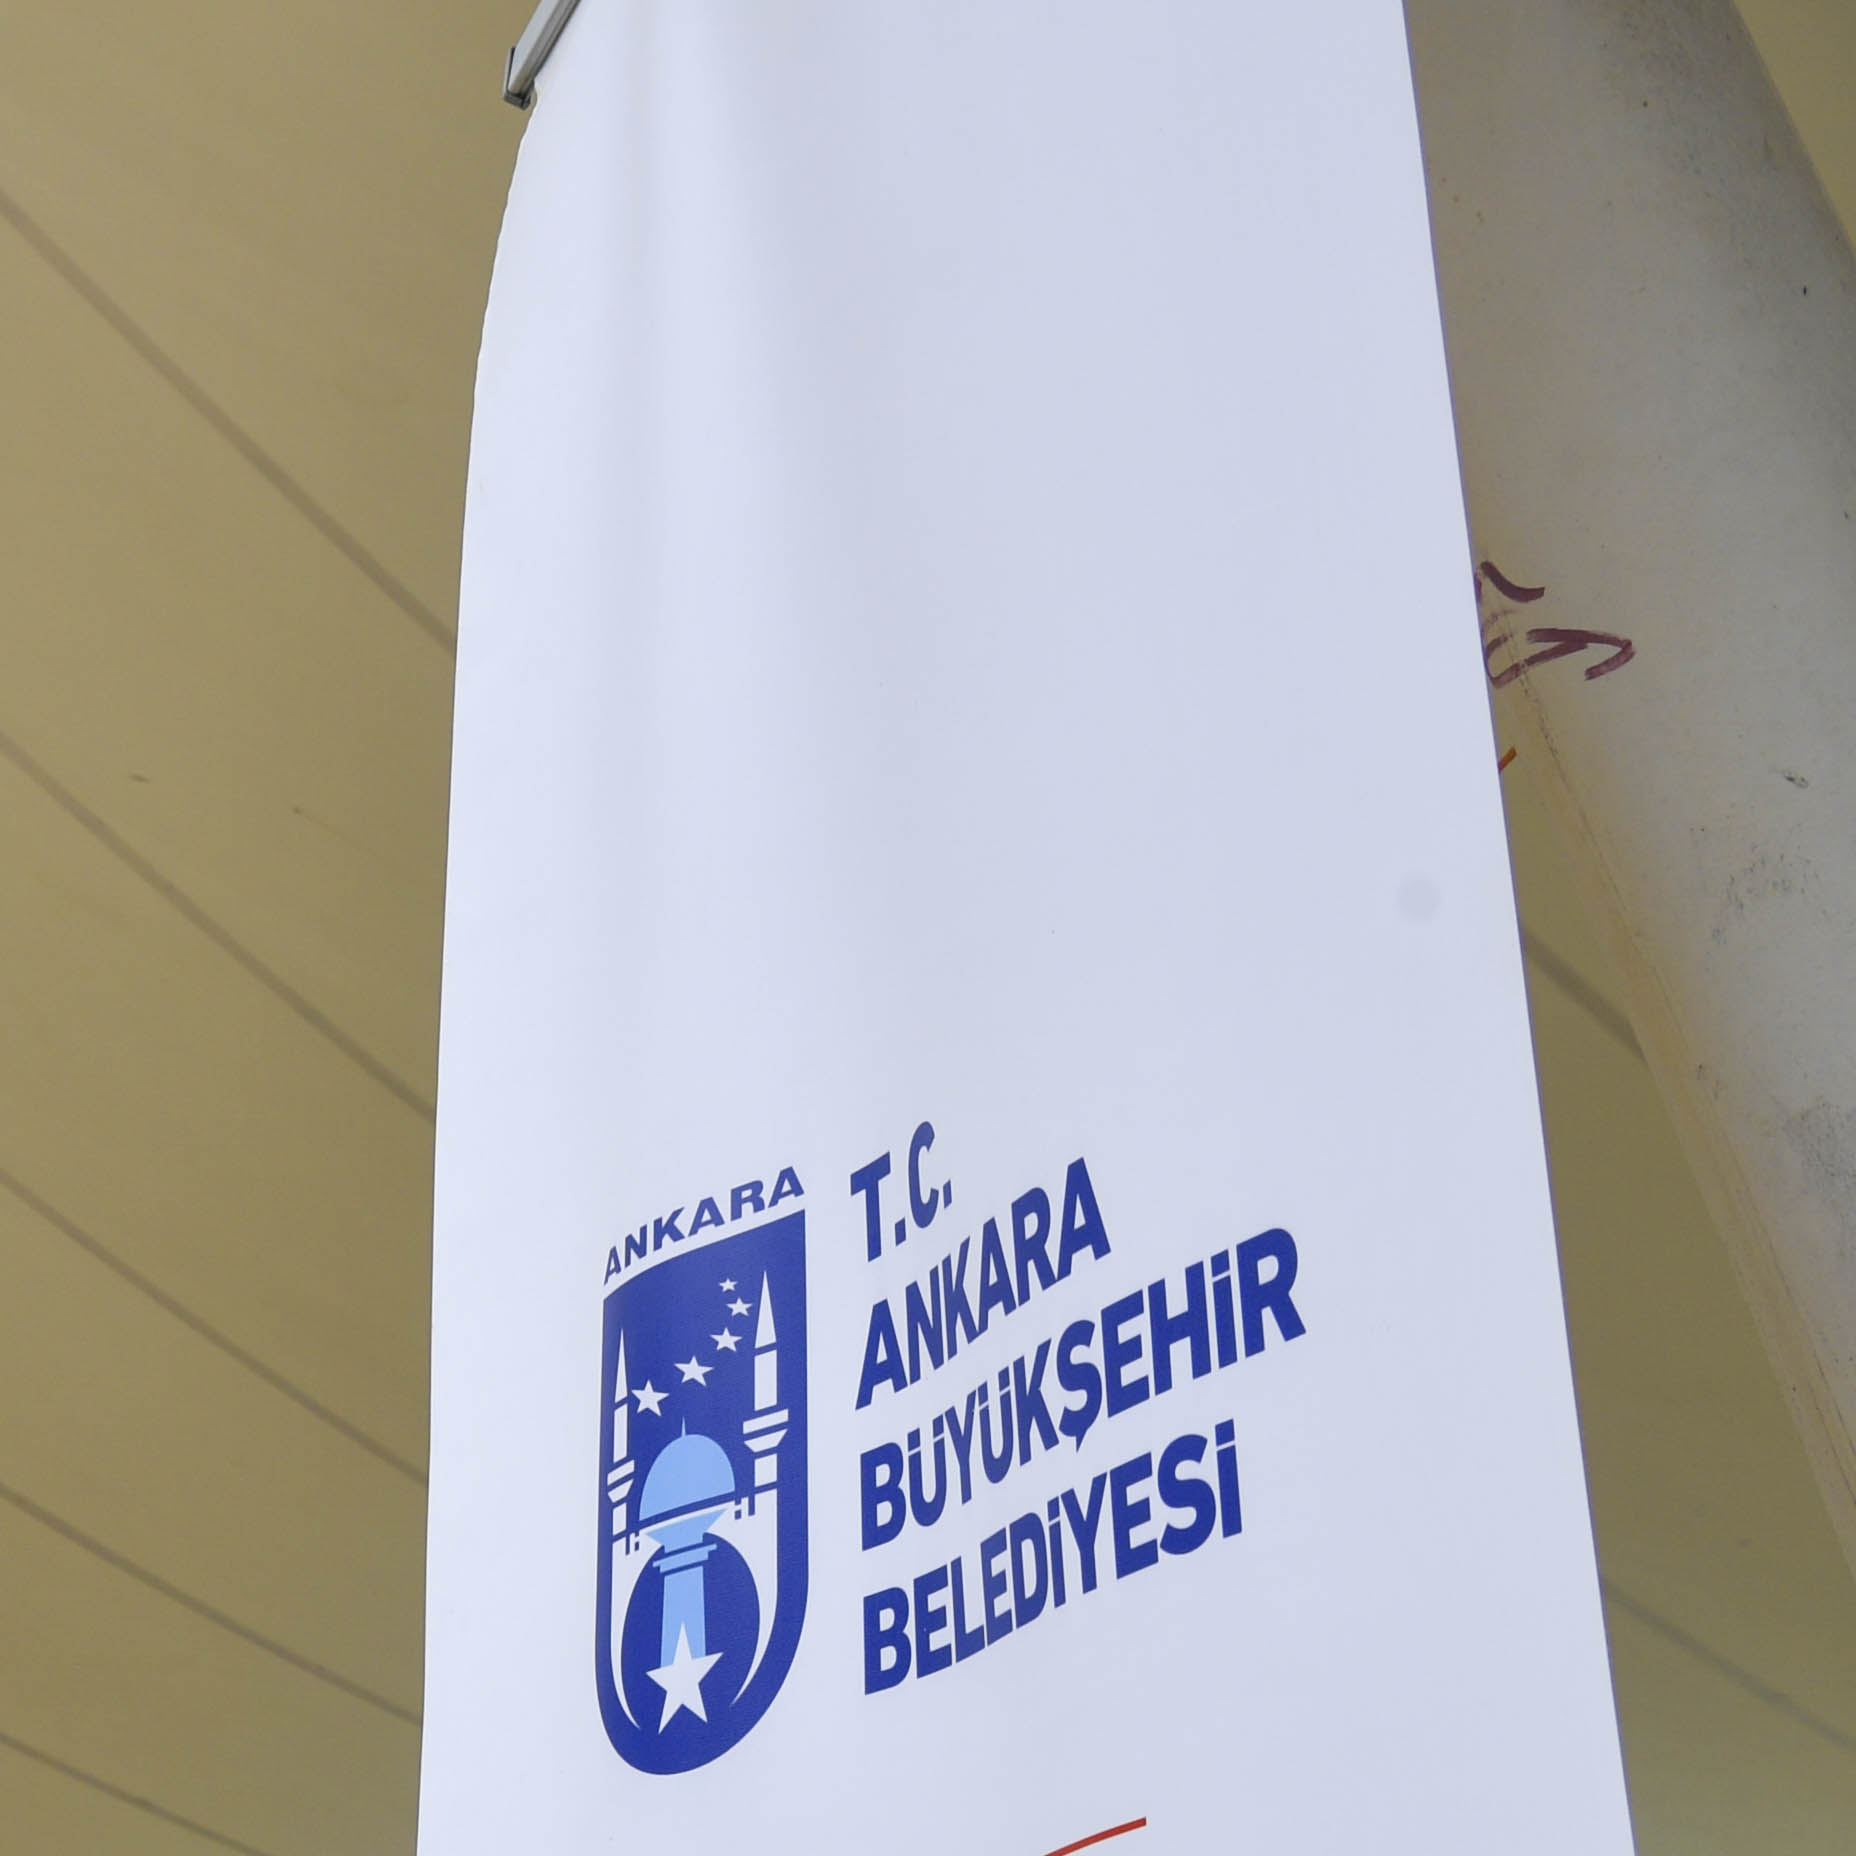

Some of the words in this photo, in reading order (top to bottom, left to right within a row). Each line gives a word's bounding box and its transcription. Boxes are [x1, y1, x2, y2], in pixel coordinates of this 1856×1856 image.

[603, 1165, 806, 1286] ANKARA
[849, 1120, 954, 1263] T.C.
[855, 1156, 1113, 1412] ANKARA
[859, 1226, 1307, 1552] BÜYÜKŞEHİR
[863, 1418, 1244, 1696] BELEDİYESİ
